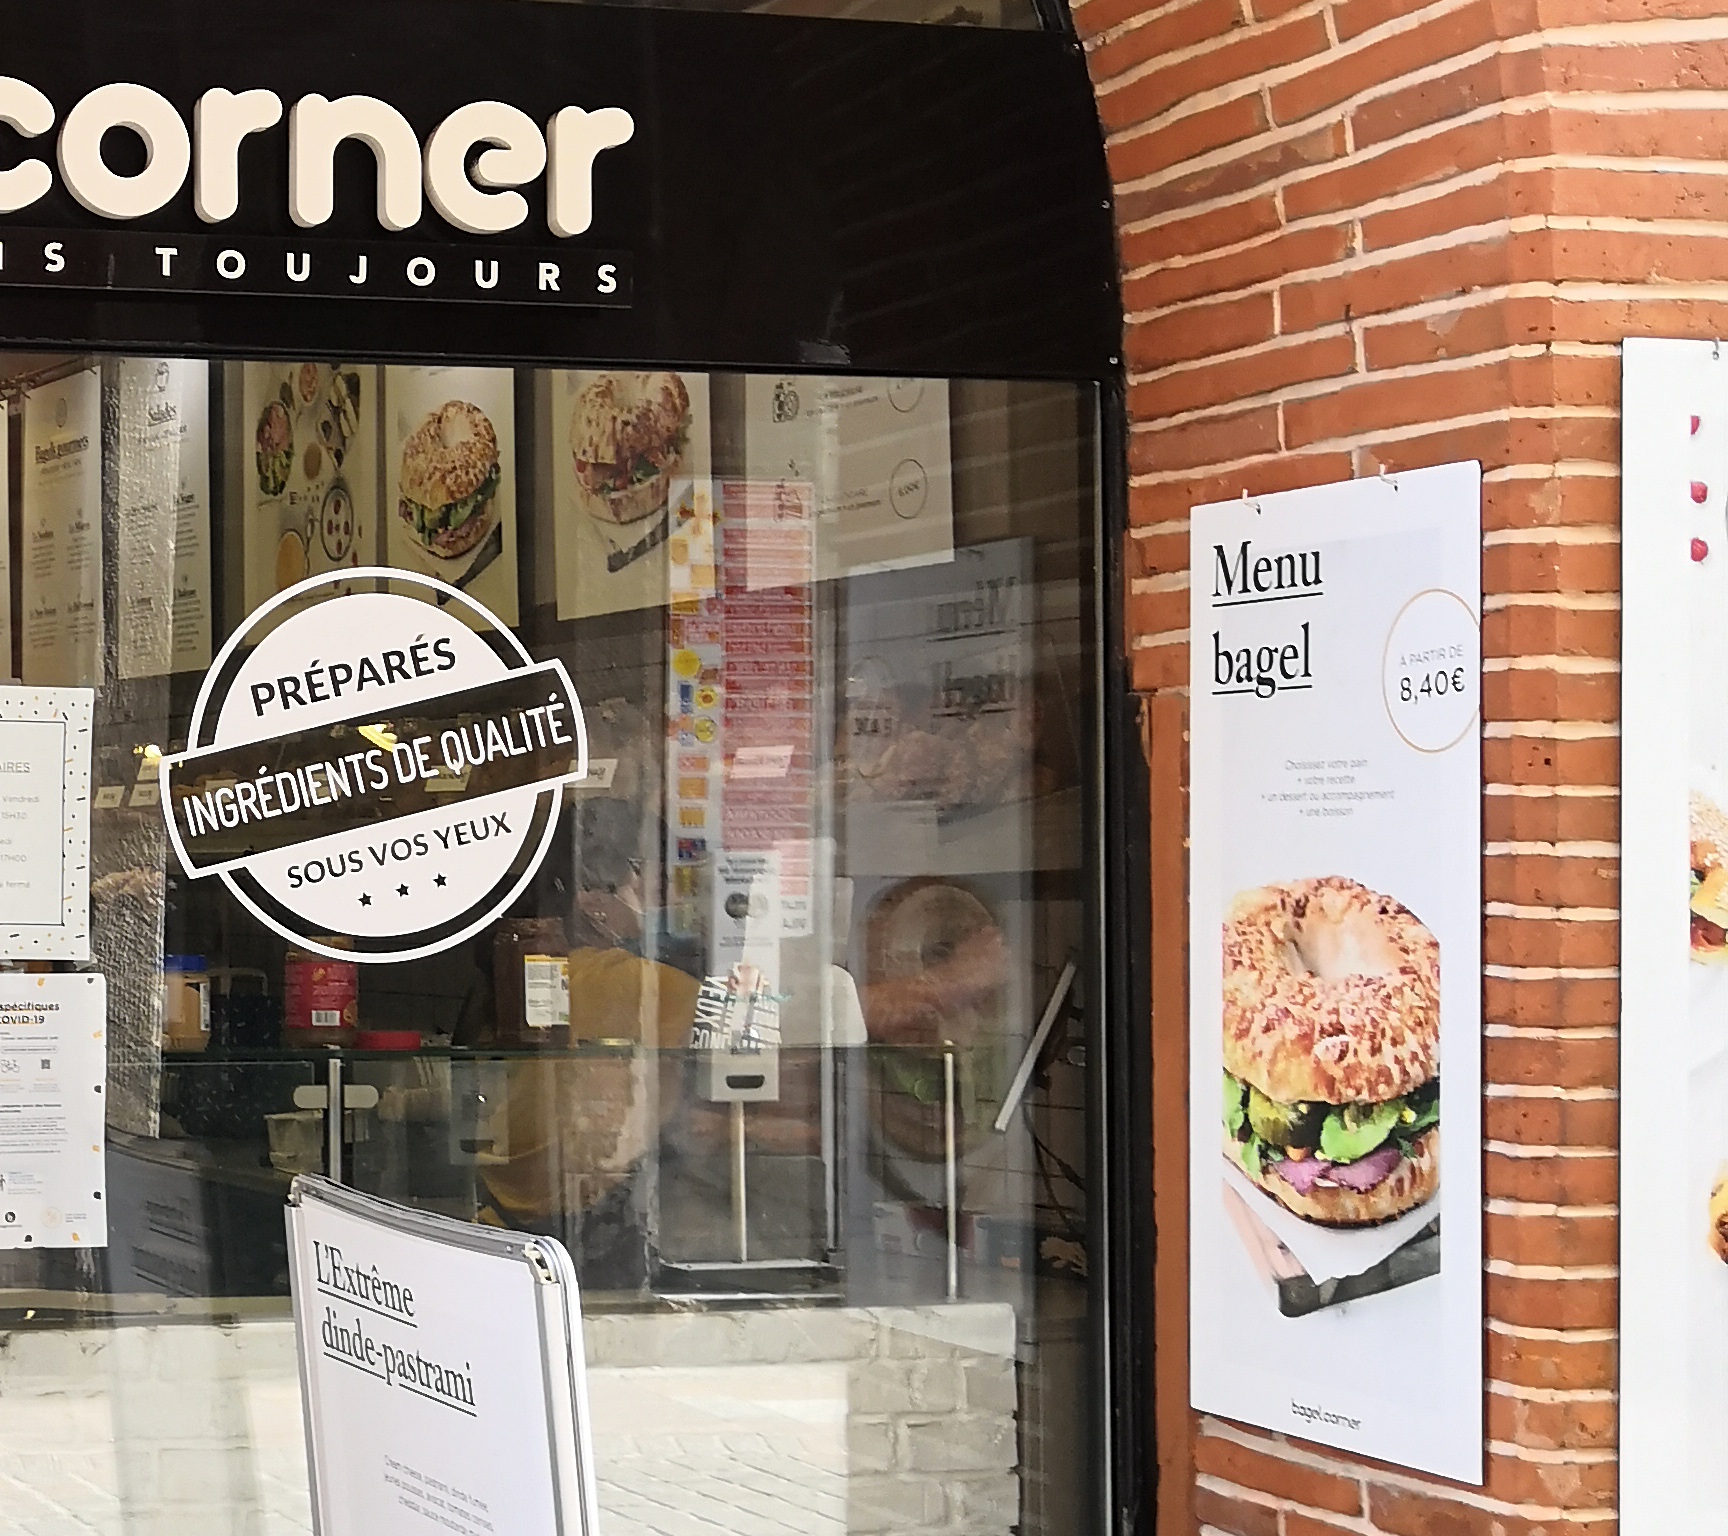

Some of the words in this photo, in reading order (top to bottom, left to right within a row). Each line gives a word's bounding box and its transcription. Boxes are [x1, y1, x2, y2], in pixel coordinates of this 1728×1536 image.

[155, 246, 618, 294] TOUJOURS
[1212, 540, 1323, 598] Menu
[250, 634, 457, 717] PRÉPARÉS
[1212, 621, 1313, 699] bagel
[1400, 667, 1465, 705] 8,40€
[183, 749, 389, 837] INGRÉDIENTS
[392, 736, 440, 784] DE
[441, 692, 573, 776] QUALITÉ
[288, 851, 364, 889] SOUS
[368, 834, 429, 866] VOS
[433, 812, 512, 850] YEUX
[0, 1001, 60, 1013] spécifiques
[313, 1240, 416, 1318] L'Extrême
[322, 1306, 476, 1407] dinde-pastrami
